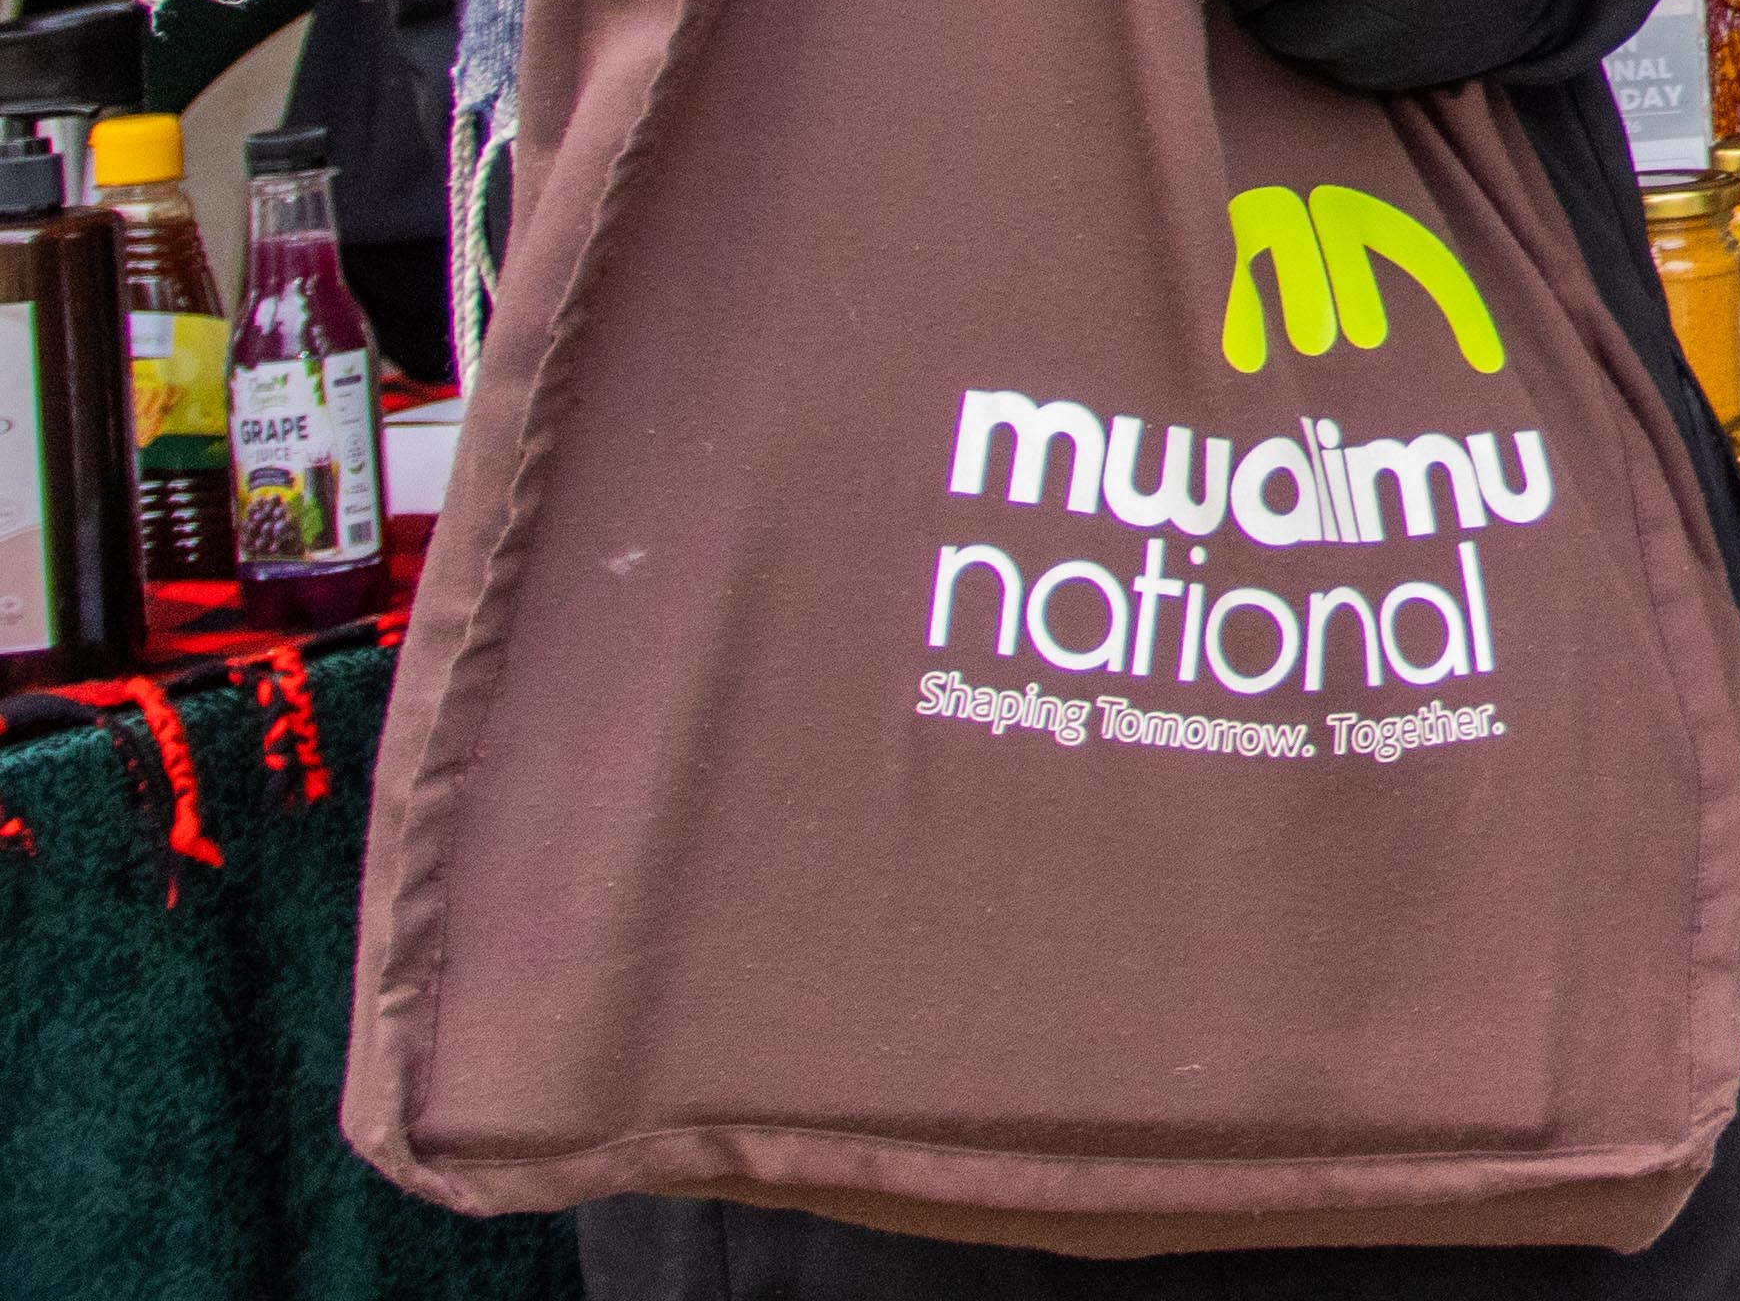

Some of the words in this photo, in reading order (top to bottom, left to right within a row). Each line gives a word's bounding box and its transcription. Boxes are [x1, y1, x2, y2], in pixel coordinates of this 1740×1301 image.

[1619, 85, 1683, 111] DAY
[240, 415, 308, 445] GRAPE
[948, 388, 1555, 547] mwalimu
[925, 536, 1495, 696] national
[915, 668, 1092, 747] Shaping
[1095, 695, 1315, 758] Tomorrow.
[1325, 699, 1506, 763] Together.
